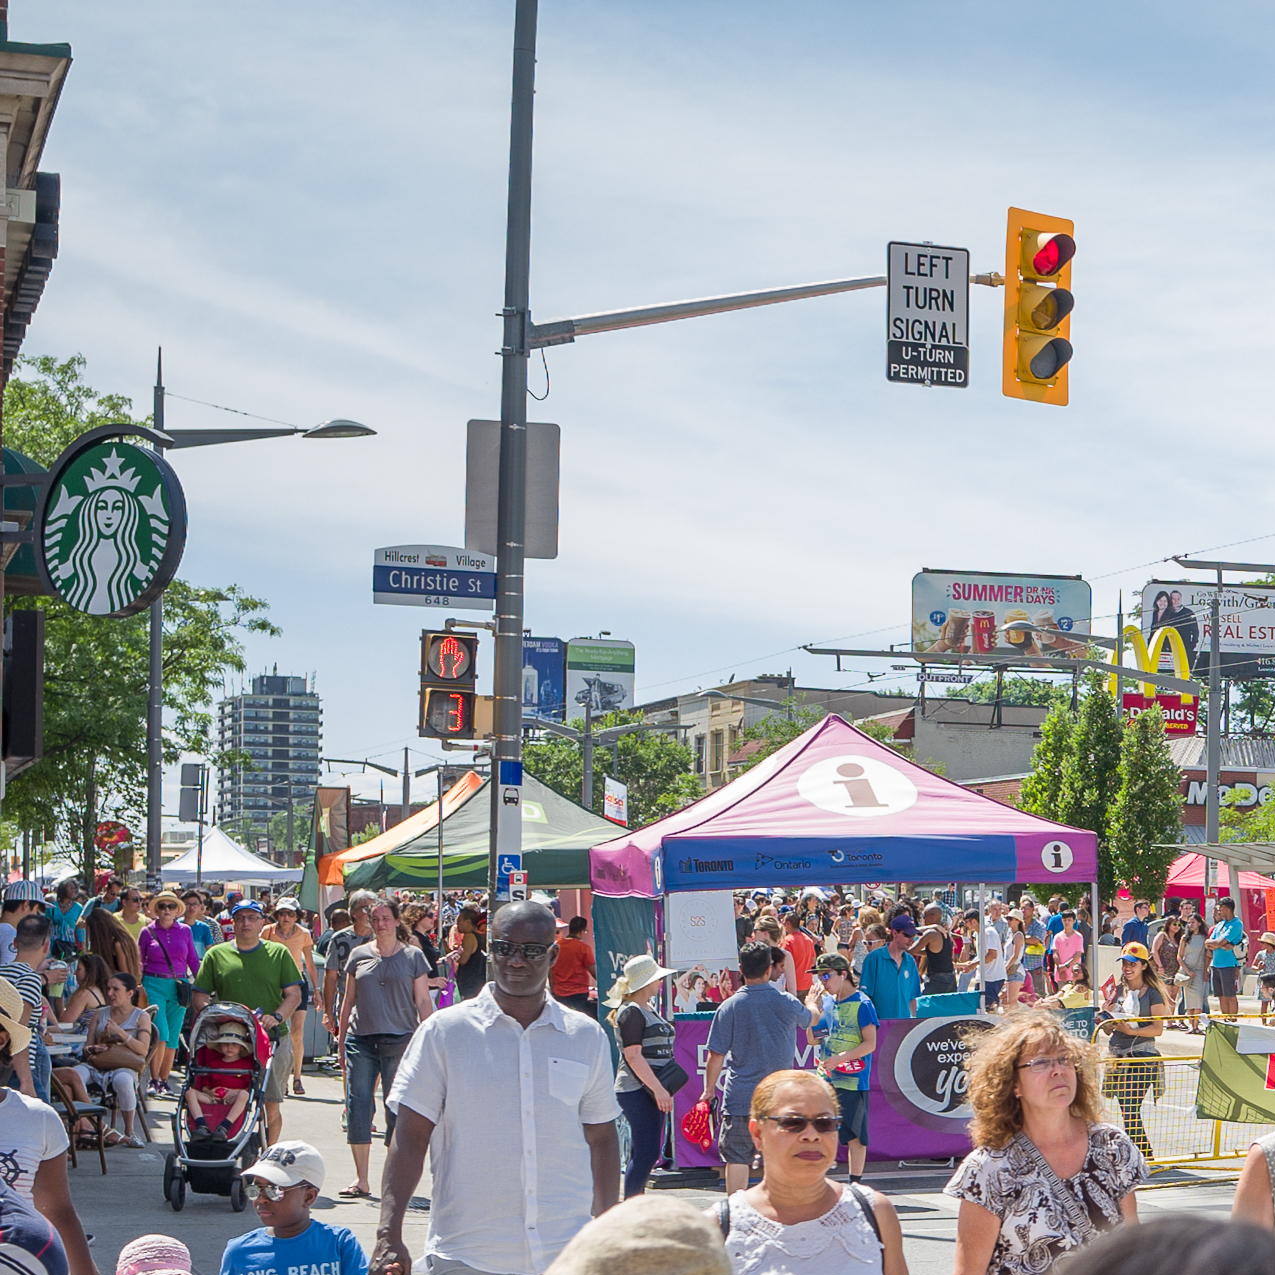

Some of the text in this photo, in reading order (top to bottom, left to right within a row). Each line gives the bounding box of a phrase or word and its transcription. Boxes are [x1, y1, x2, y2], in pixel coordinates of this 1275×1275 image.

[904, 252, 953, 280] LEFT
[902, 285, 954, 312] TURN
[892, 317, 964, 346] SIGNAL
[902, 346, 954, 364] U-TURN
[890, 364, 965, 383] PERMITTED
[384, 551, 486, 569] Hillcrest Village
[389, 570, 482, 593] Christie St
[425, 596, 450, 606] 648
[952, 582, 1024, 604] SUMMER
[1026, 594, 1055, 605] DAYS
[1221, 615, 1242, 623] SELL
[918, 674, 971, 683] OUTFRONT
[693, 858, 734, 872] TORONTO
[774, 860, 811, 869] Ontario
[926, 1038, 966, 1051] we've
[937, 1049, 976, 1064] expec
